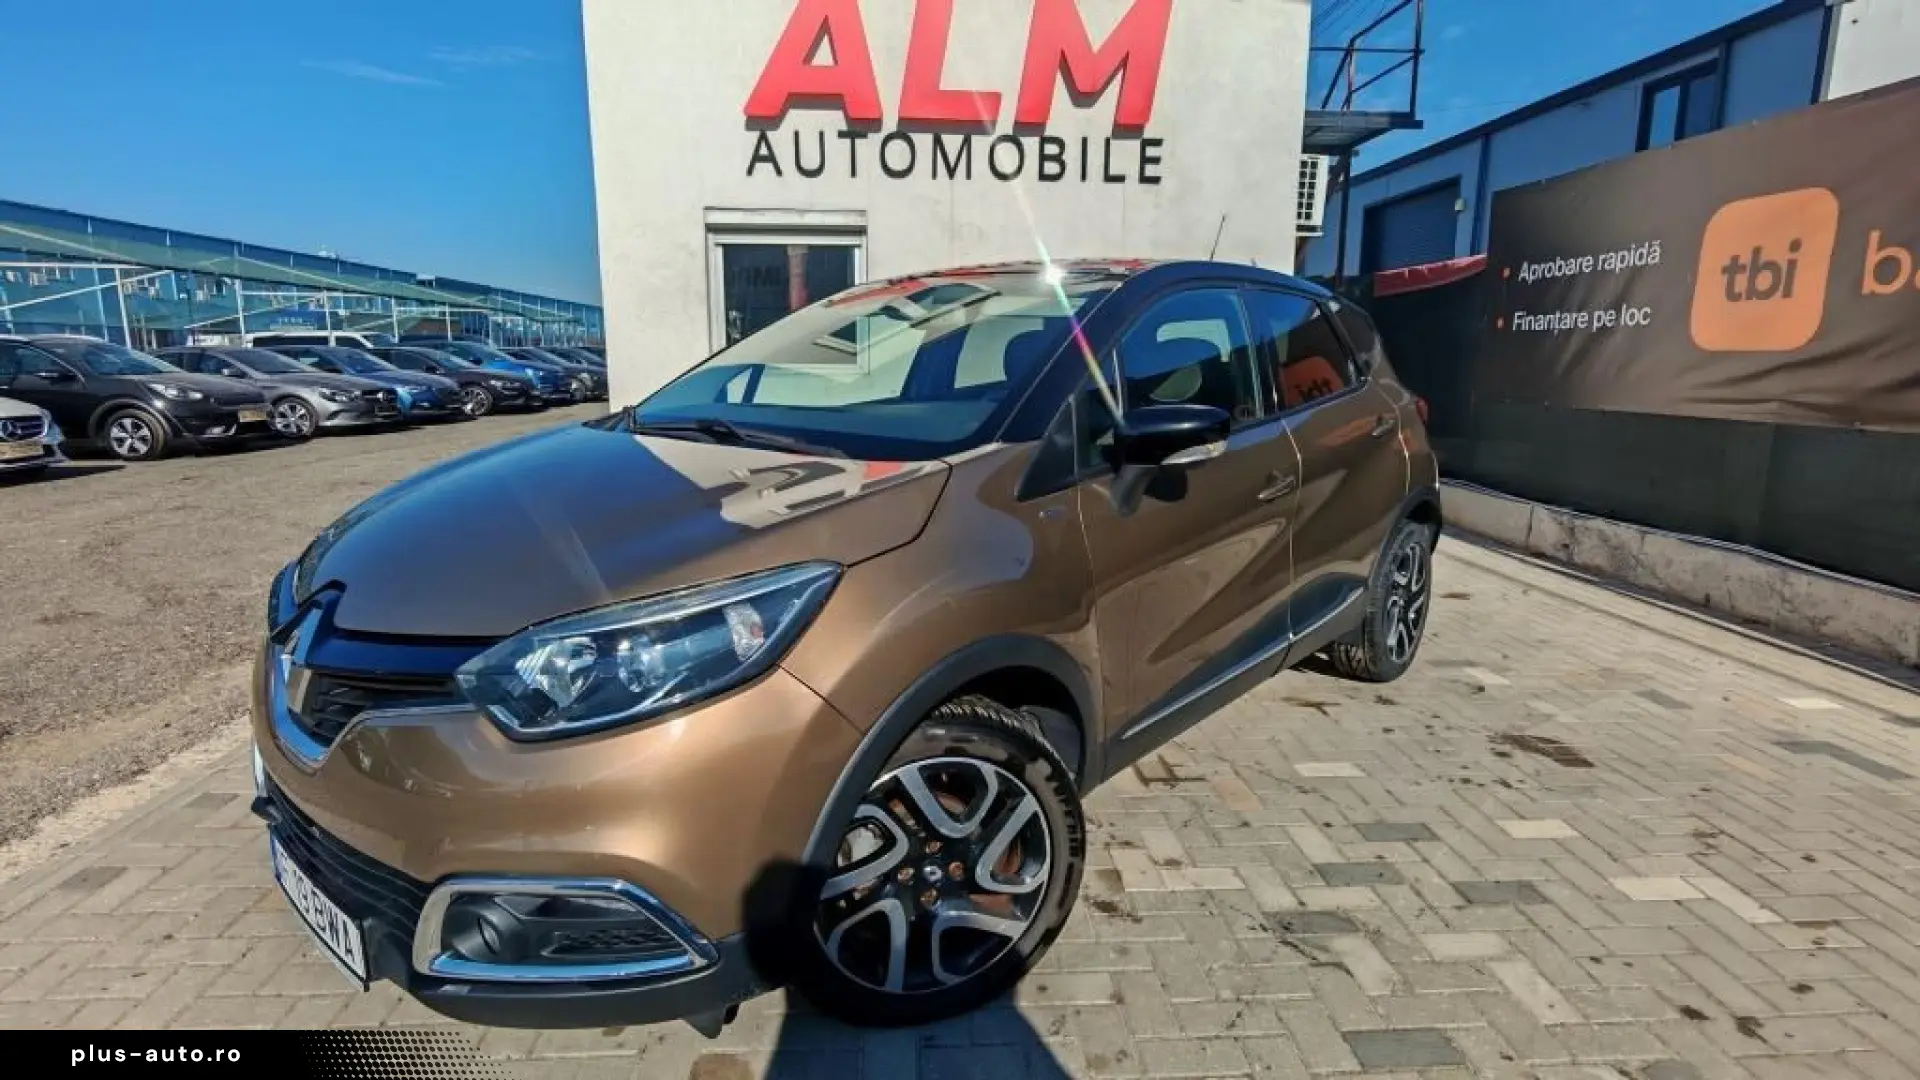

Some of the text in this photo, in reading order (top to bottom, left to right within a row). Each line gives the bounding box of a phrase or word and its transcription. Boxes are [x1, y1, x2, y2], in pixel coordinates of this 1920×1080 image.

[743, 0, 1173, 131] ALM
[747, 130, 1164, 185] AUTOMOBILE
[1518, 240, 1662, 284] Aprobare rapidă
[1720, 229, 1920, 303] tbi b
[1512, 303, 1651, 336] Finanțare pe loc
